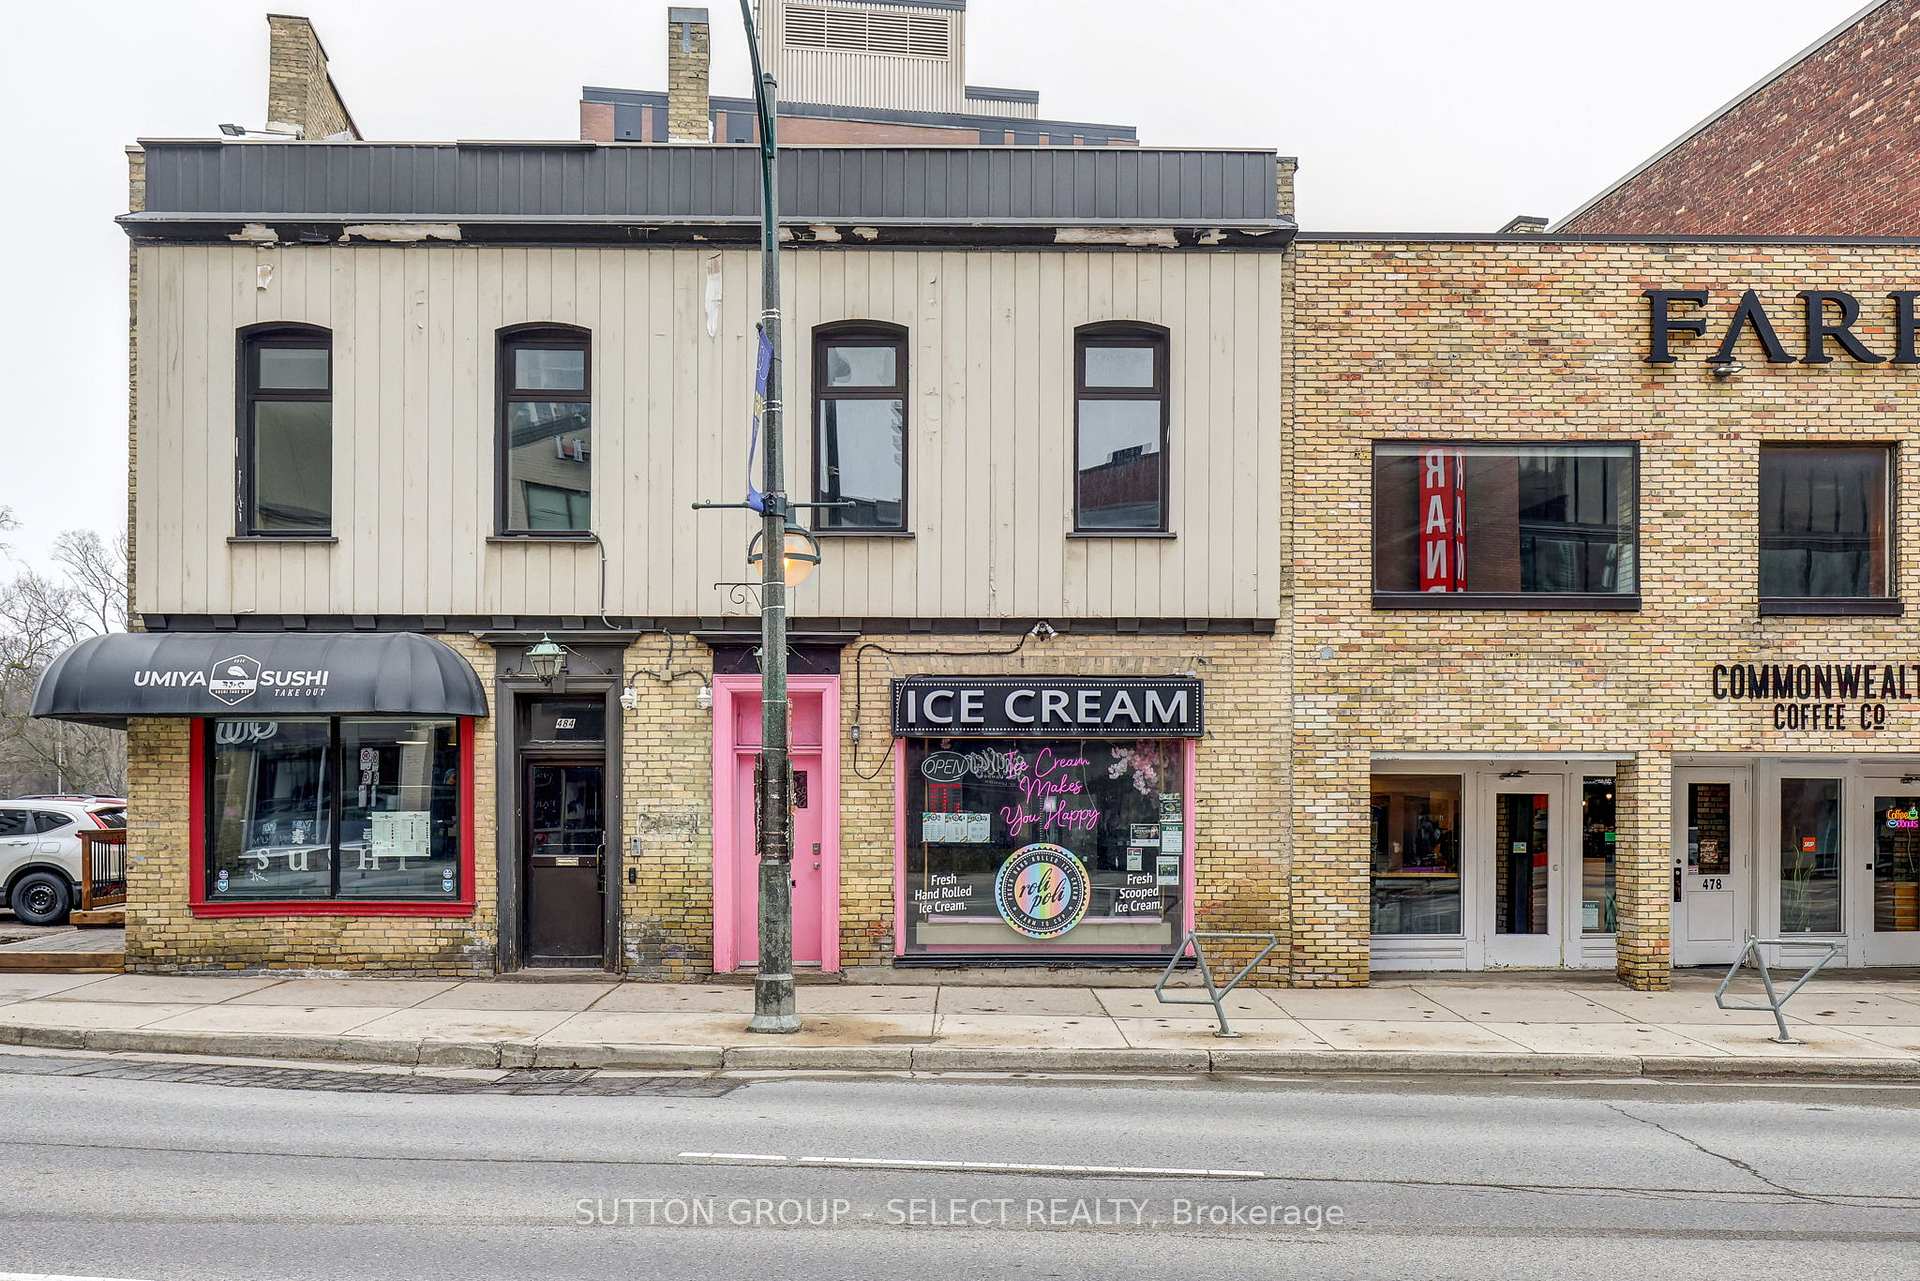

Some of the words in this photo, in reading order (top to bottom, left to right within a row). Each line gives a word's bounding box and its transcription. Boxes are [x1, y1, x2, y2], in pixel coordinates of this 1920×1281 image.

[134, 671, 207, 687] UMIYA
[260, 670, 329, 687] SUSHI
[274, 688, 300, 697] TAKE
[305, 688, 325, 696] OUT
[907, 690, 985, 724] ICE
[1004, 690, 1188, 724] CREAM
[556, 719, 575, 728] 484
[1774, 703, 1846, 730] COFFEE
[924, 759, 965, 775] OPEN
[1035, 747, 1090, 778] Cream
[1020, 774, 1083, 804] Makes
[1000, 803, 1041, 836] You
[1044, 800, 1100, 831] Happy
[931, 873, 957, 886] Fresh
[1019, 867, 1053, 898] roli
[1127, 872, 1153, 885] Fresh
[1702, 878, 1722, 890] 478
[914, 887, 940, 901] Hand
[941, 885, 972, 899] Rolled
[1028, 878, 1067, 915] poli
[1119, 887, 1159, 900] Scooped
[919, 902, 933, 914] Ice
[934, 901, 967, 912] Cream.
[1114, 902, 1128, 913] Ice
[1130, 900, 1163, 912] Cream.
